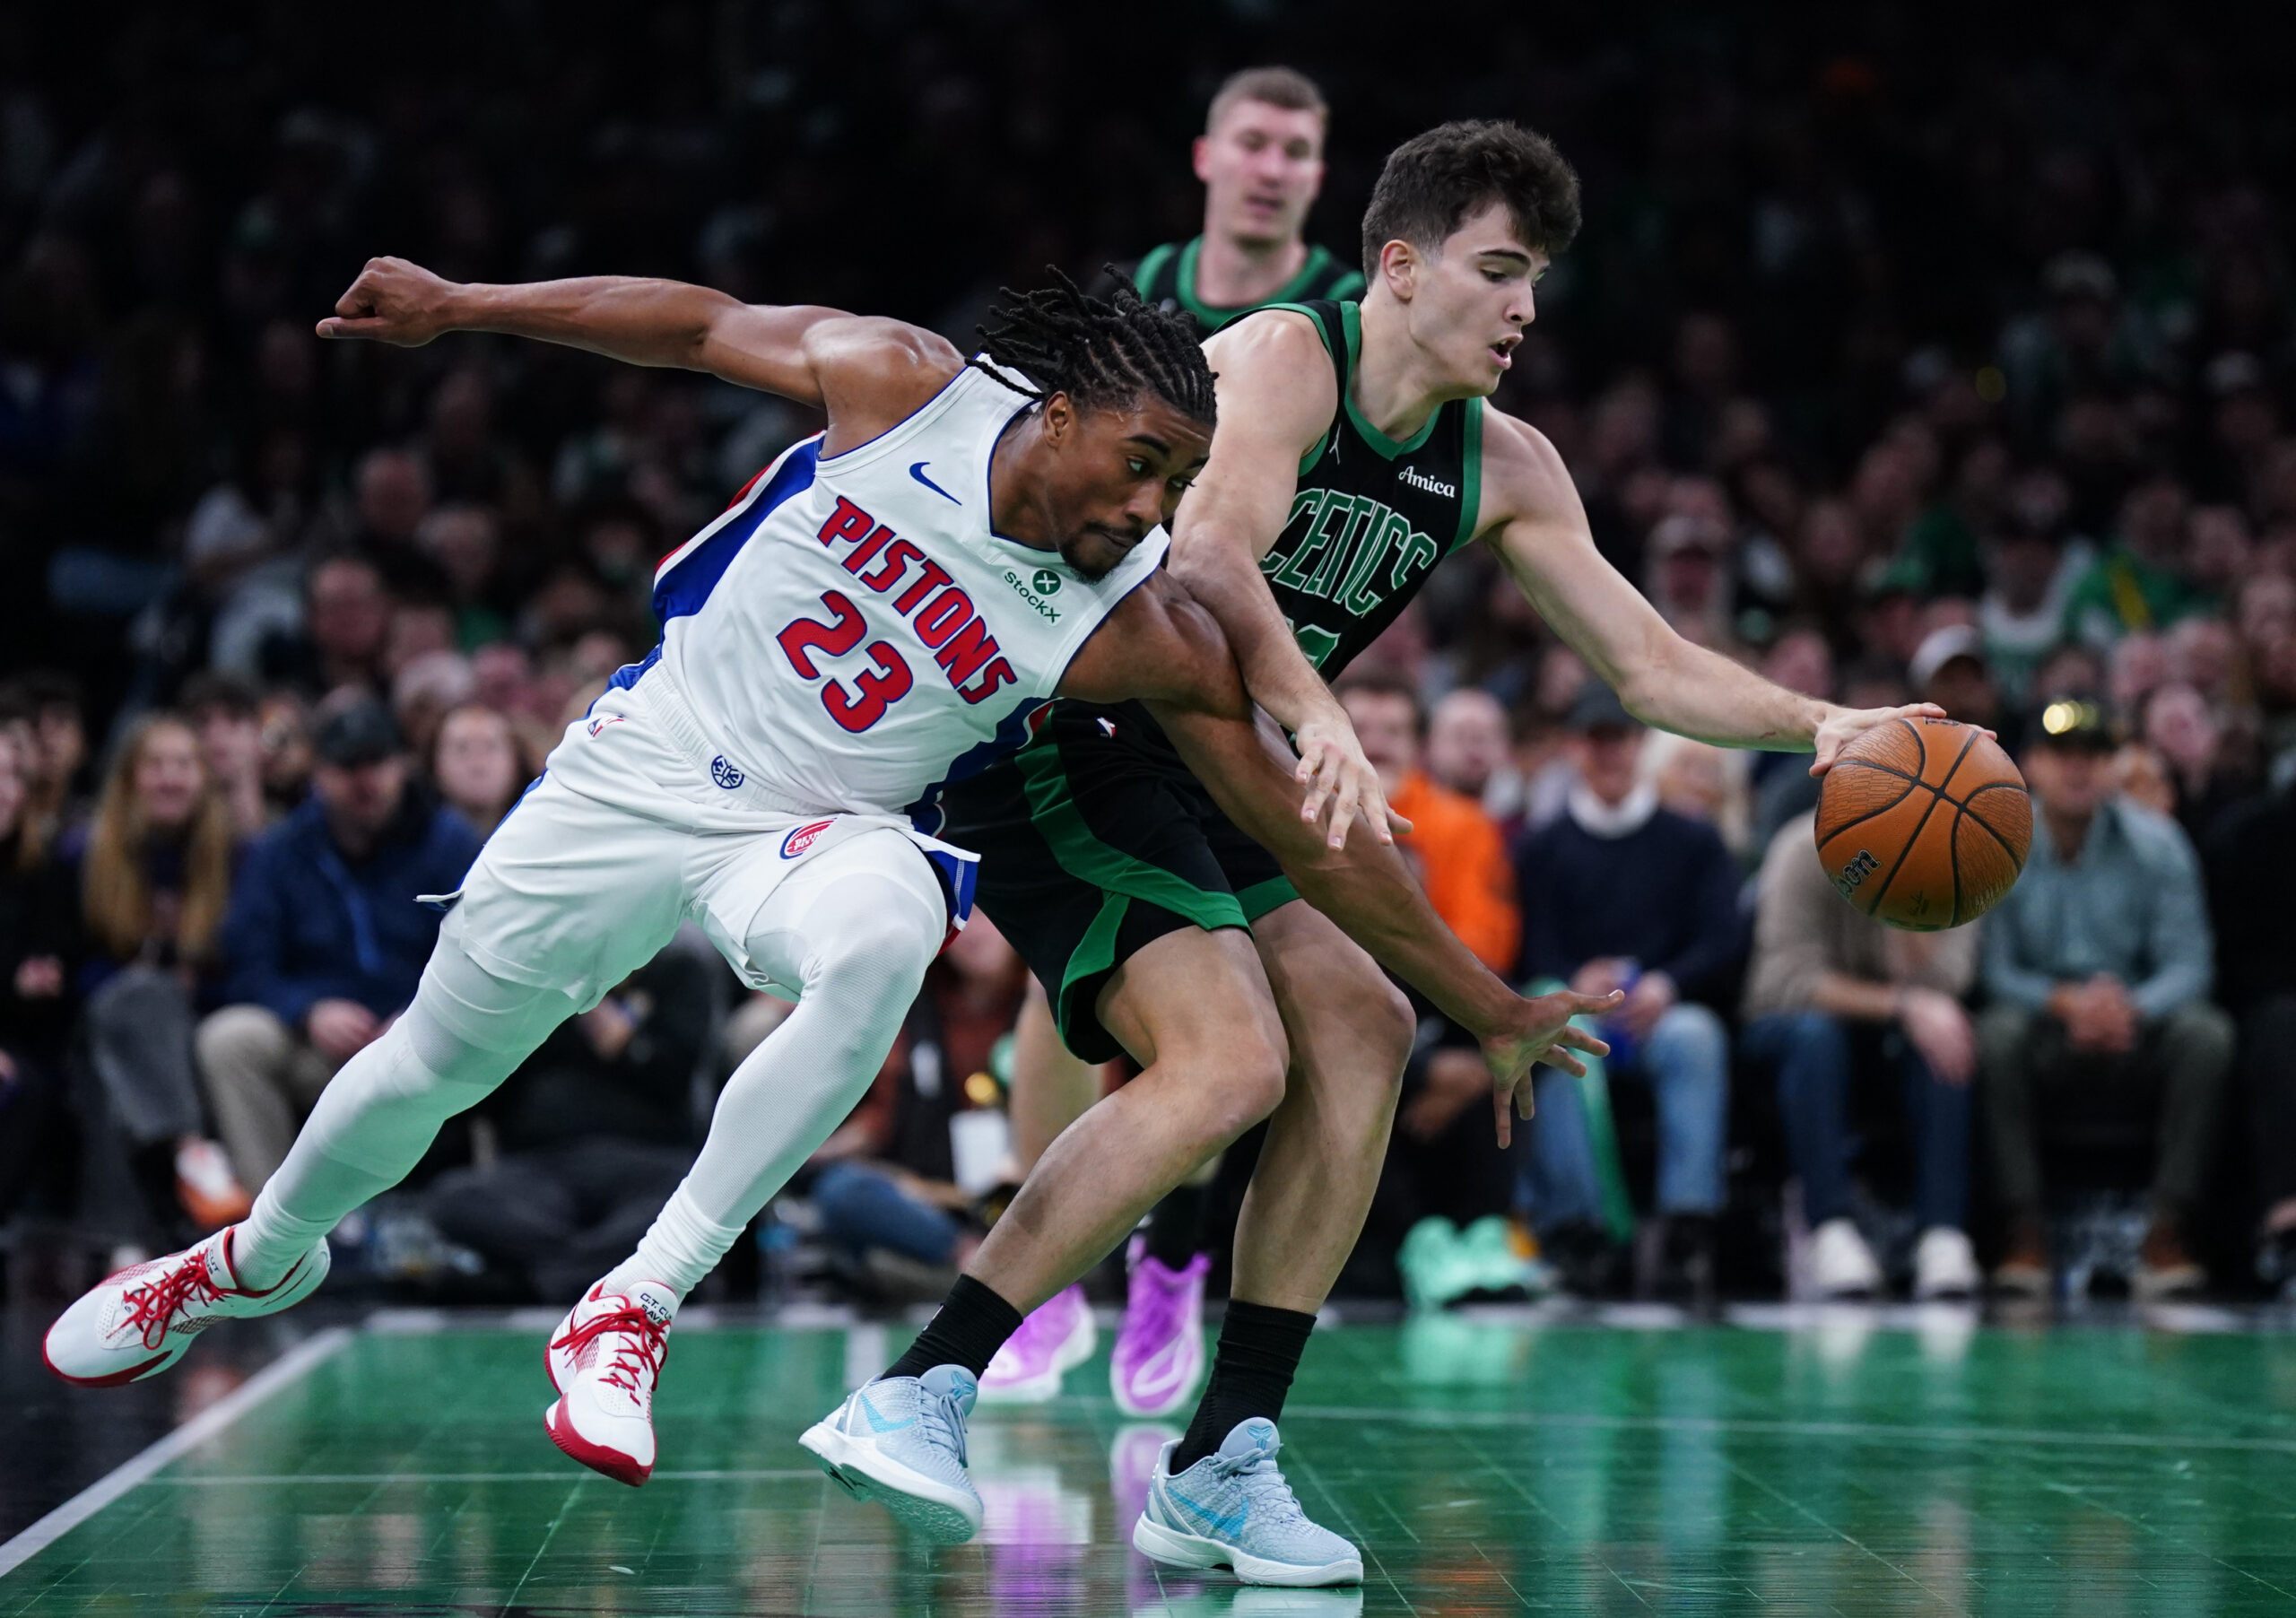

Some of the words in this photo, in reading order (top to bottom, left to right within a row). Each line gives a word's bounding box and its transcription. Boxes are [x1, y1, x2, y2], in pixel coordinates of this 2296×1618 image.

[1398, 465, 1455, 498] Amica
[817, 495, 1018, 704] PISTONS
[1004, 571, 1062, 623] StockX
[777, 590, 913, 733] 23
